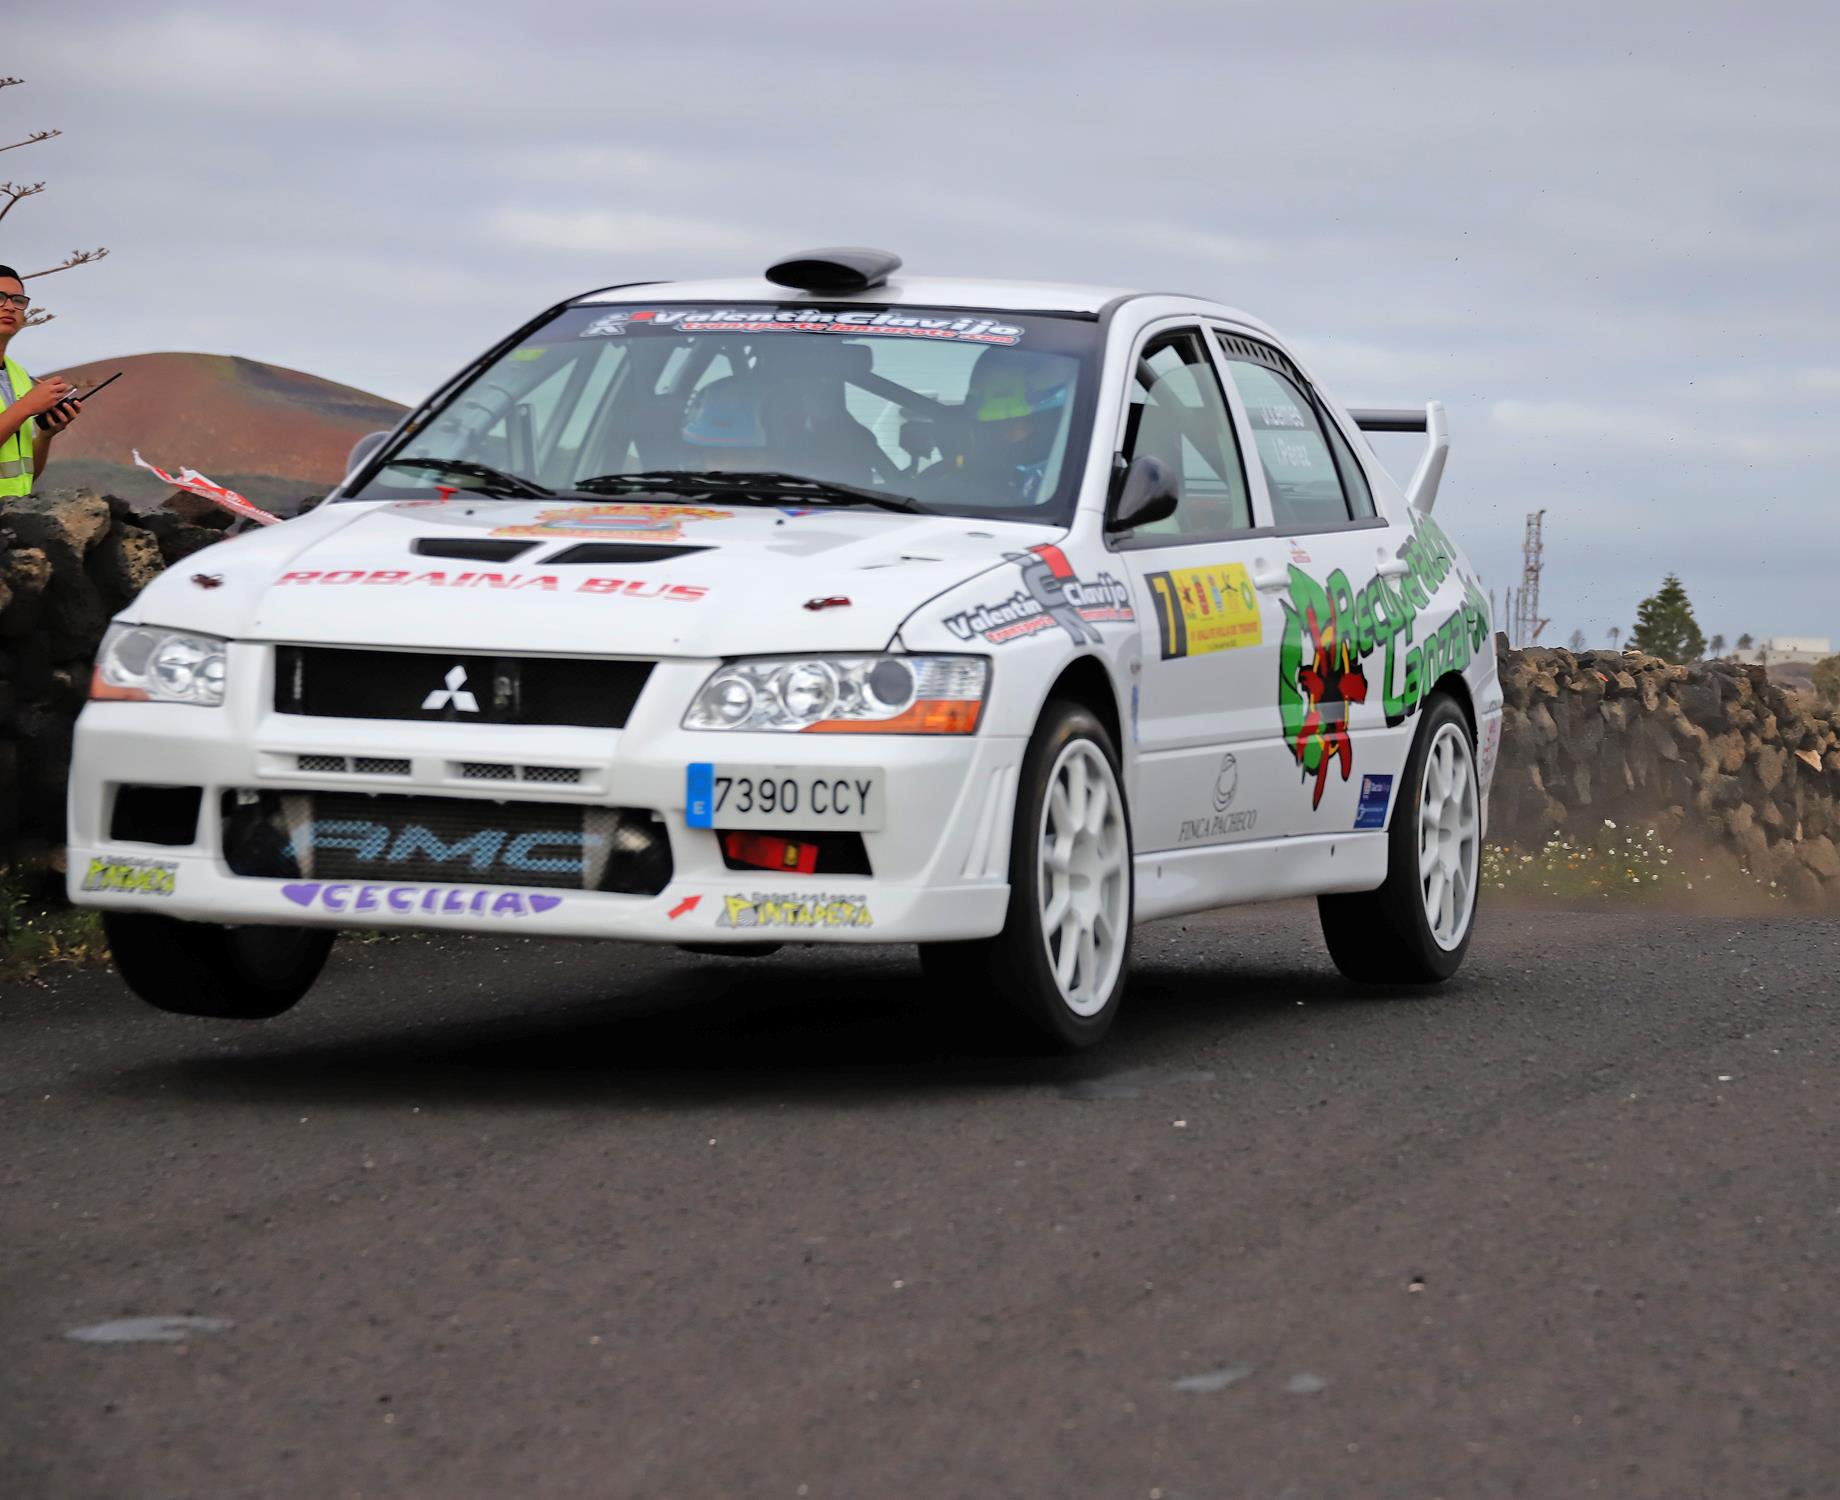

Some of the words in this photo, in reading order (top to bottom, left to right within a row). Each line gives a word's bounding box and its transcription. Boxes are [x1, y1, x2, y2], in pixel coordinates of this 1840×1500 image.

[274, 571, 558, 591] ROBAINA
[575, 578, 710, 602] BUS
[947, 591, 1043, 640] Valentin
[1062, 574, 1128, 610] Clavijo
[693, 801, 705, 814] E
[714, 777, 799, 814] 7390
[811, 780, 871, 815] CCY
[1178, 818, 1209, 842] FINCA
[1210, 809, 1257, 837] PACHECO
[321, 884, 528, 916] CECILIA
